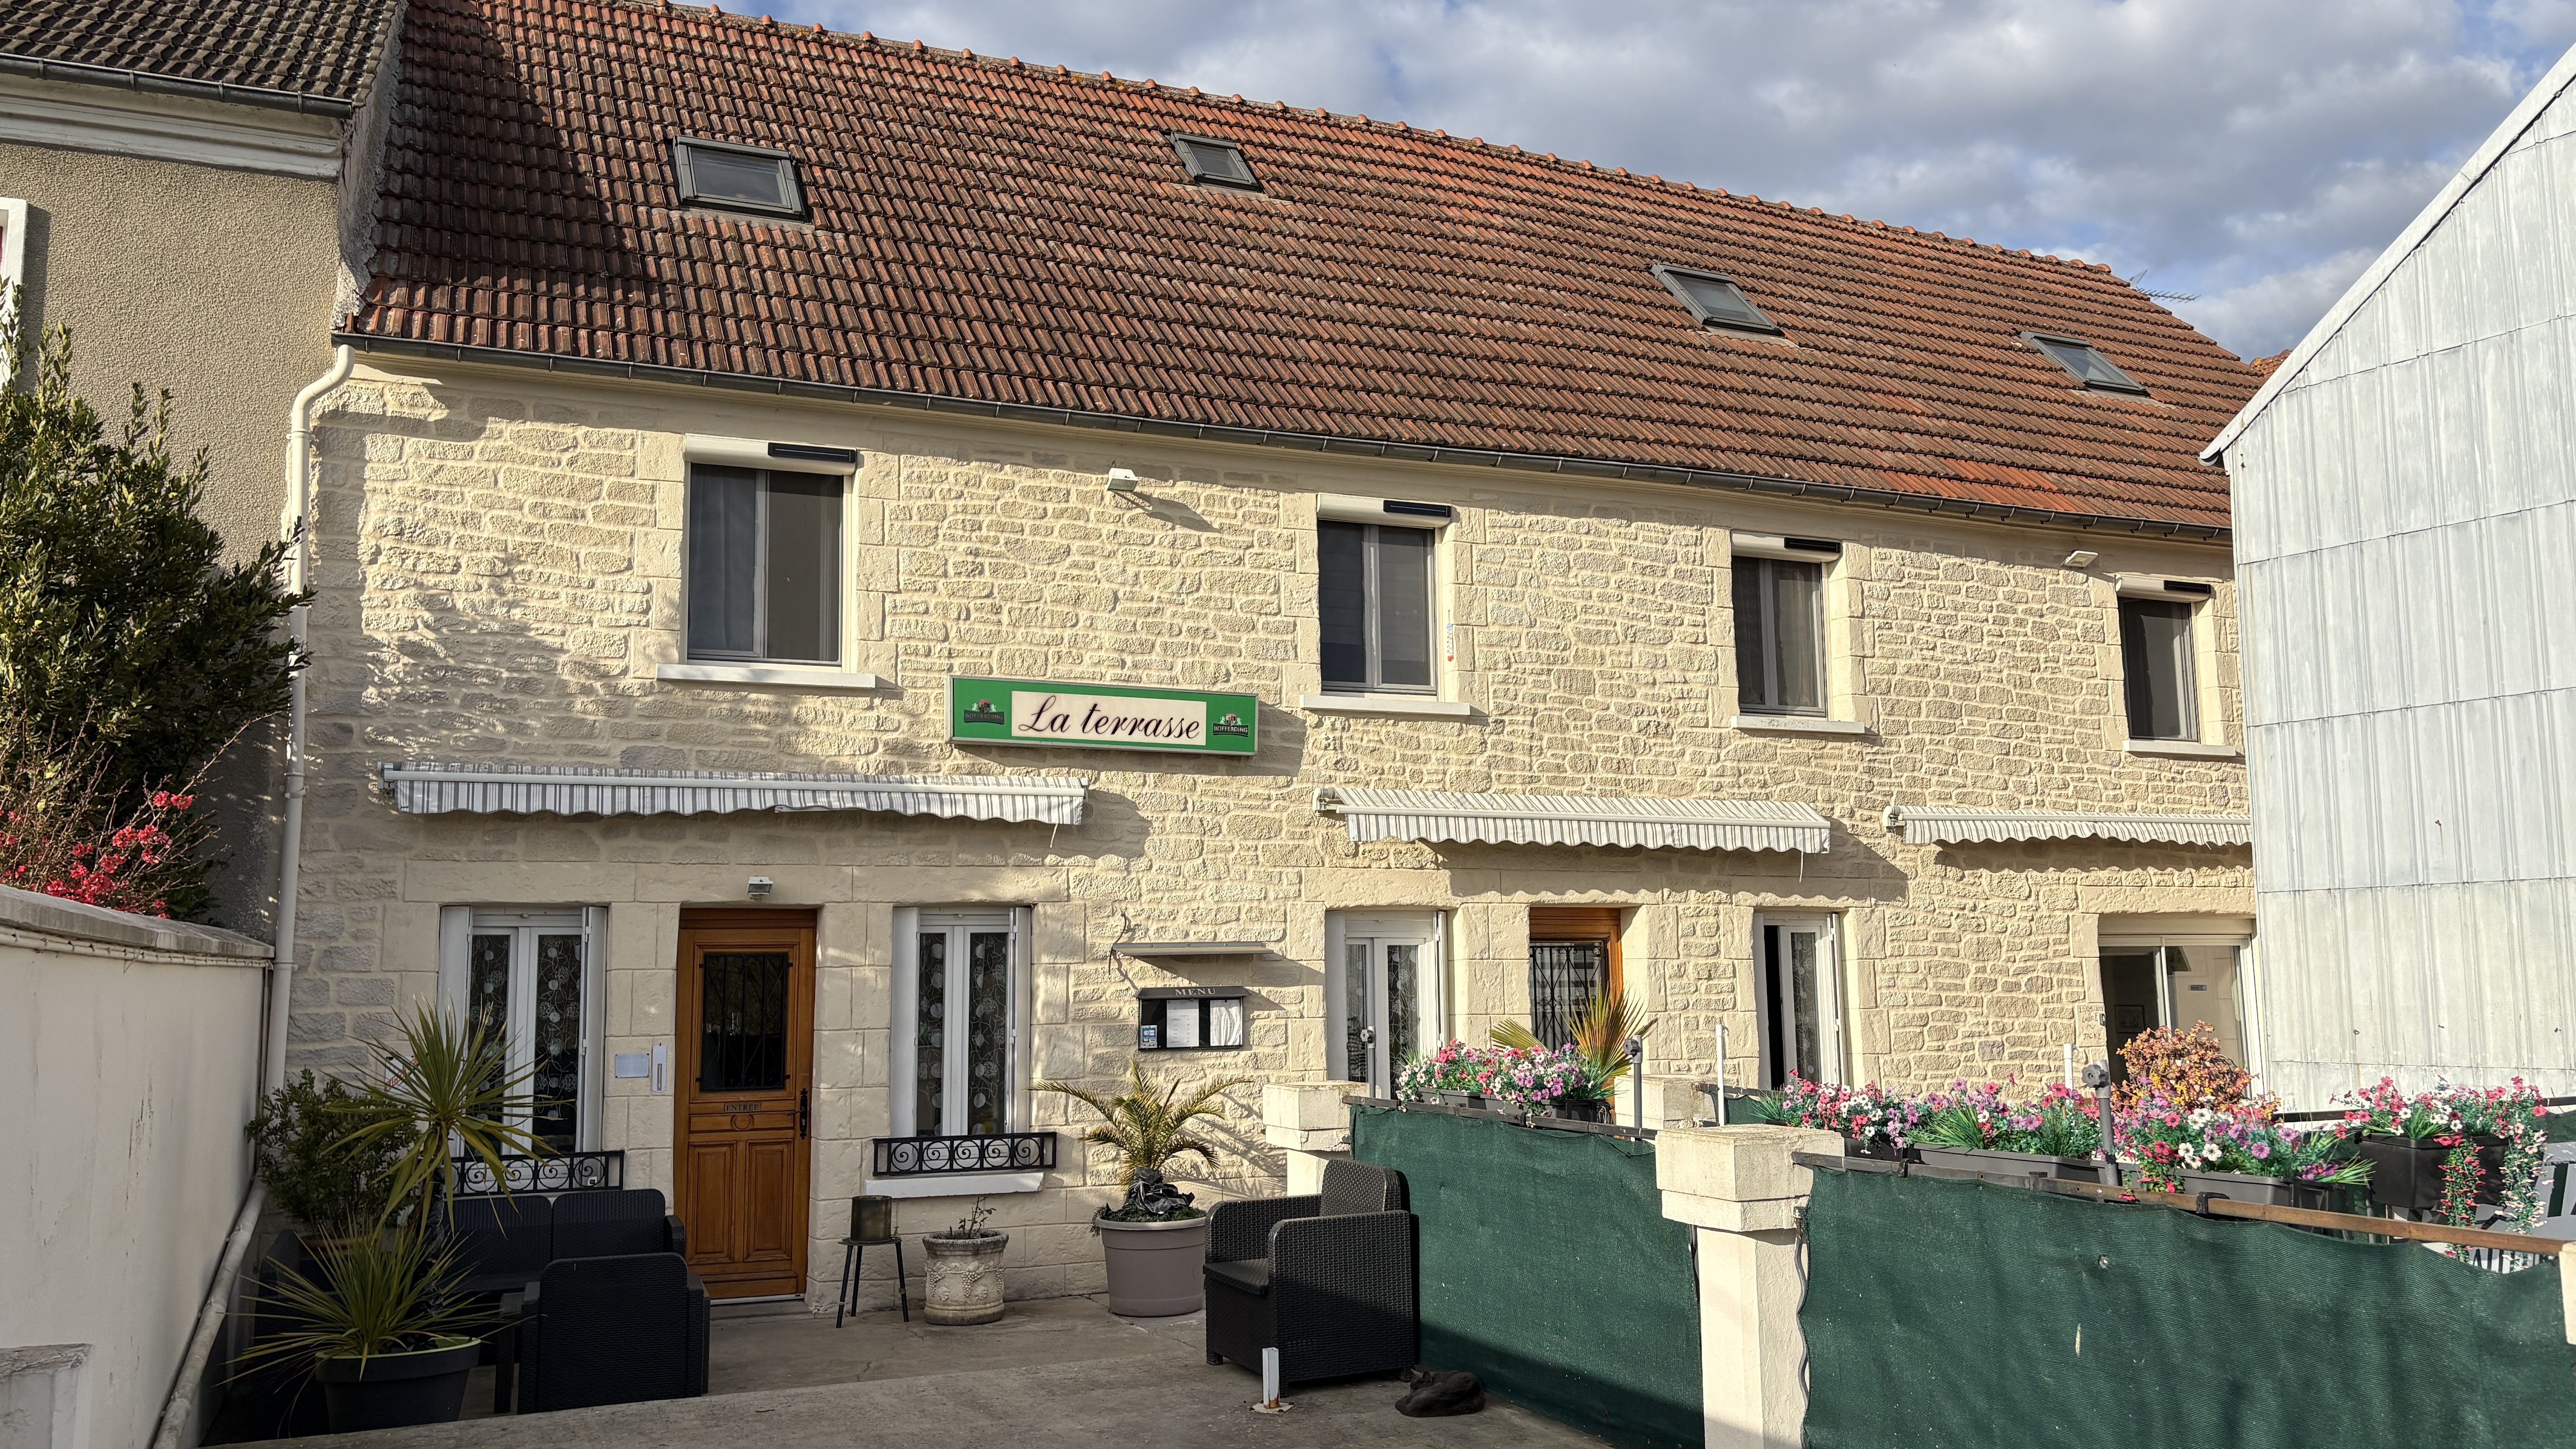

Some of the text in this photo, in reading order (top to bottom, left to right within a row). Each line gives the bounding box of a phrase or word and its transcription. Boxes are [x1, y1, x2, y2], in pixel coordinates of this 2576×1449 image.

[1018, 695, 1200, 739] La terrasse
[1213, 725, 1248, 733] BOFFERDING
